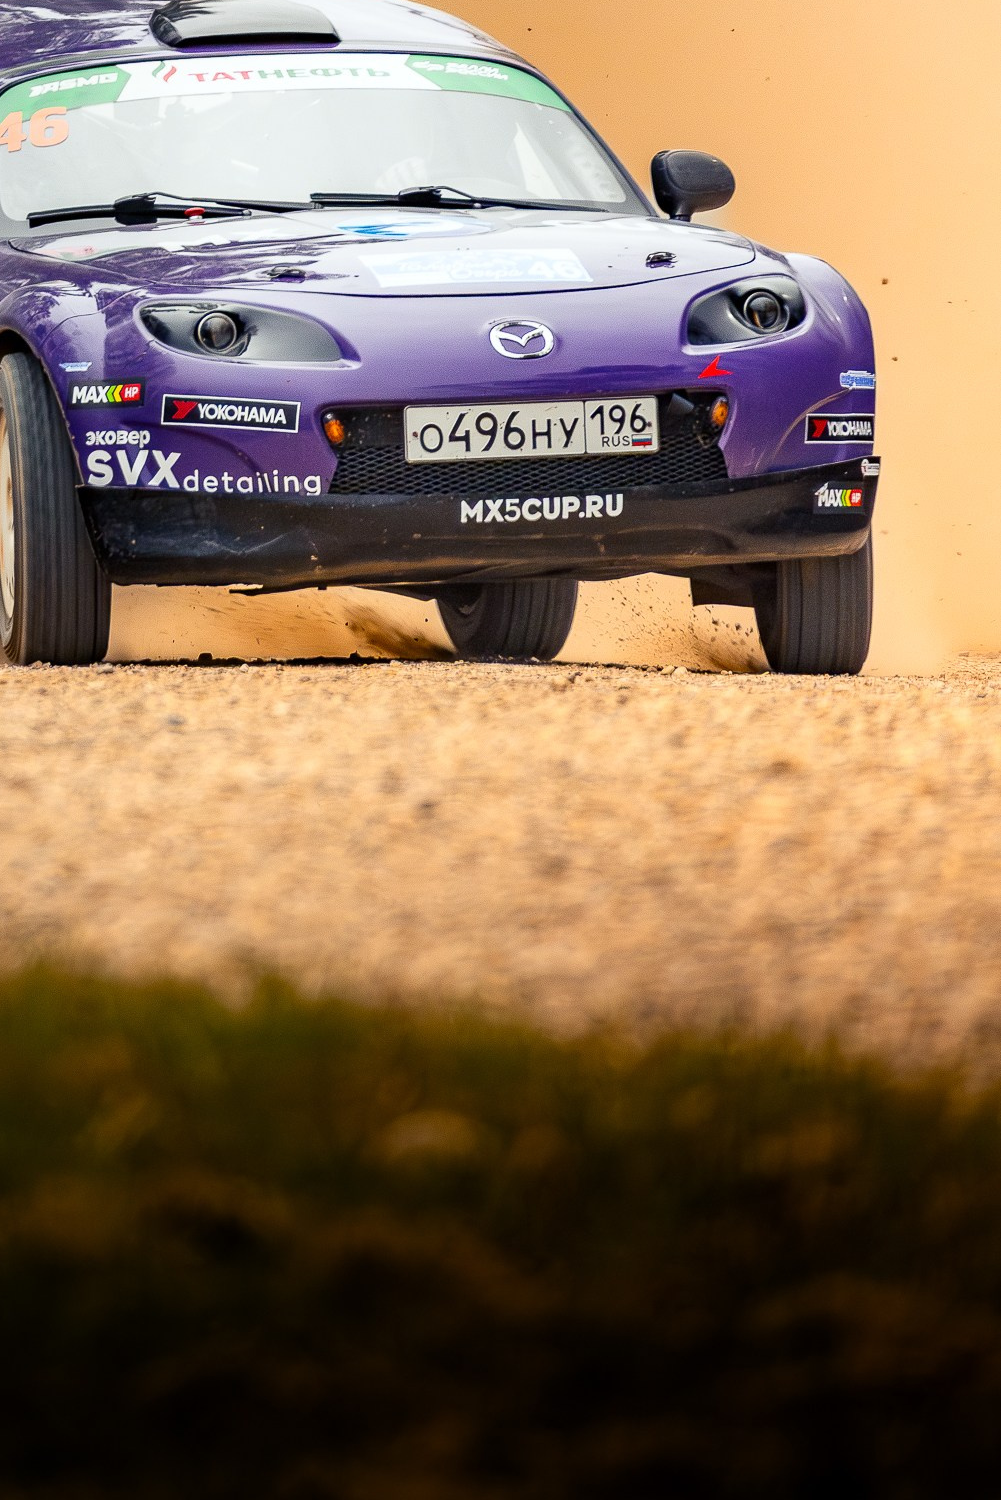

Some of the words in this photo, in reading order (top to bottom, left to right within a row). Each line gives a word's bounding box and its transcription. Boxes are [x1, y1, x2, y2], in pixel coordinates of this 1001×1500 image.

[187, 67, 391, 83] ТАТНЕФТЬ
[72, 385, 110, 404] MAX
[124, 386, 139, 399] HP
[197, 403, 287, 424] YOKOHAMA
[590, 403, 647, 435] 196
[827, 420, 873, 436] YOKOHAMA
[602, 435, 631, 447] RUS
[87, 449, 182, 488] SVX
[183, 469, 321, 496] detailing
[460, 493, 625, 524] MX5CUP.RU
